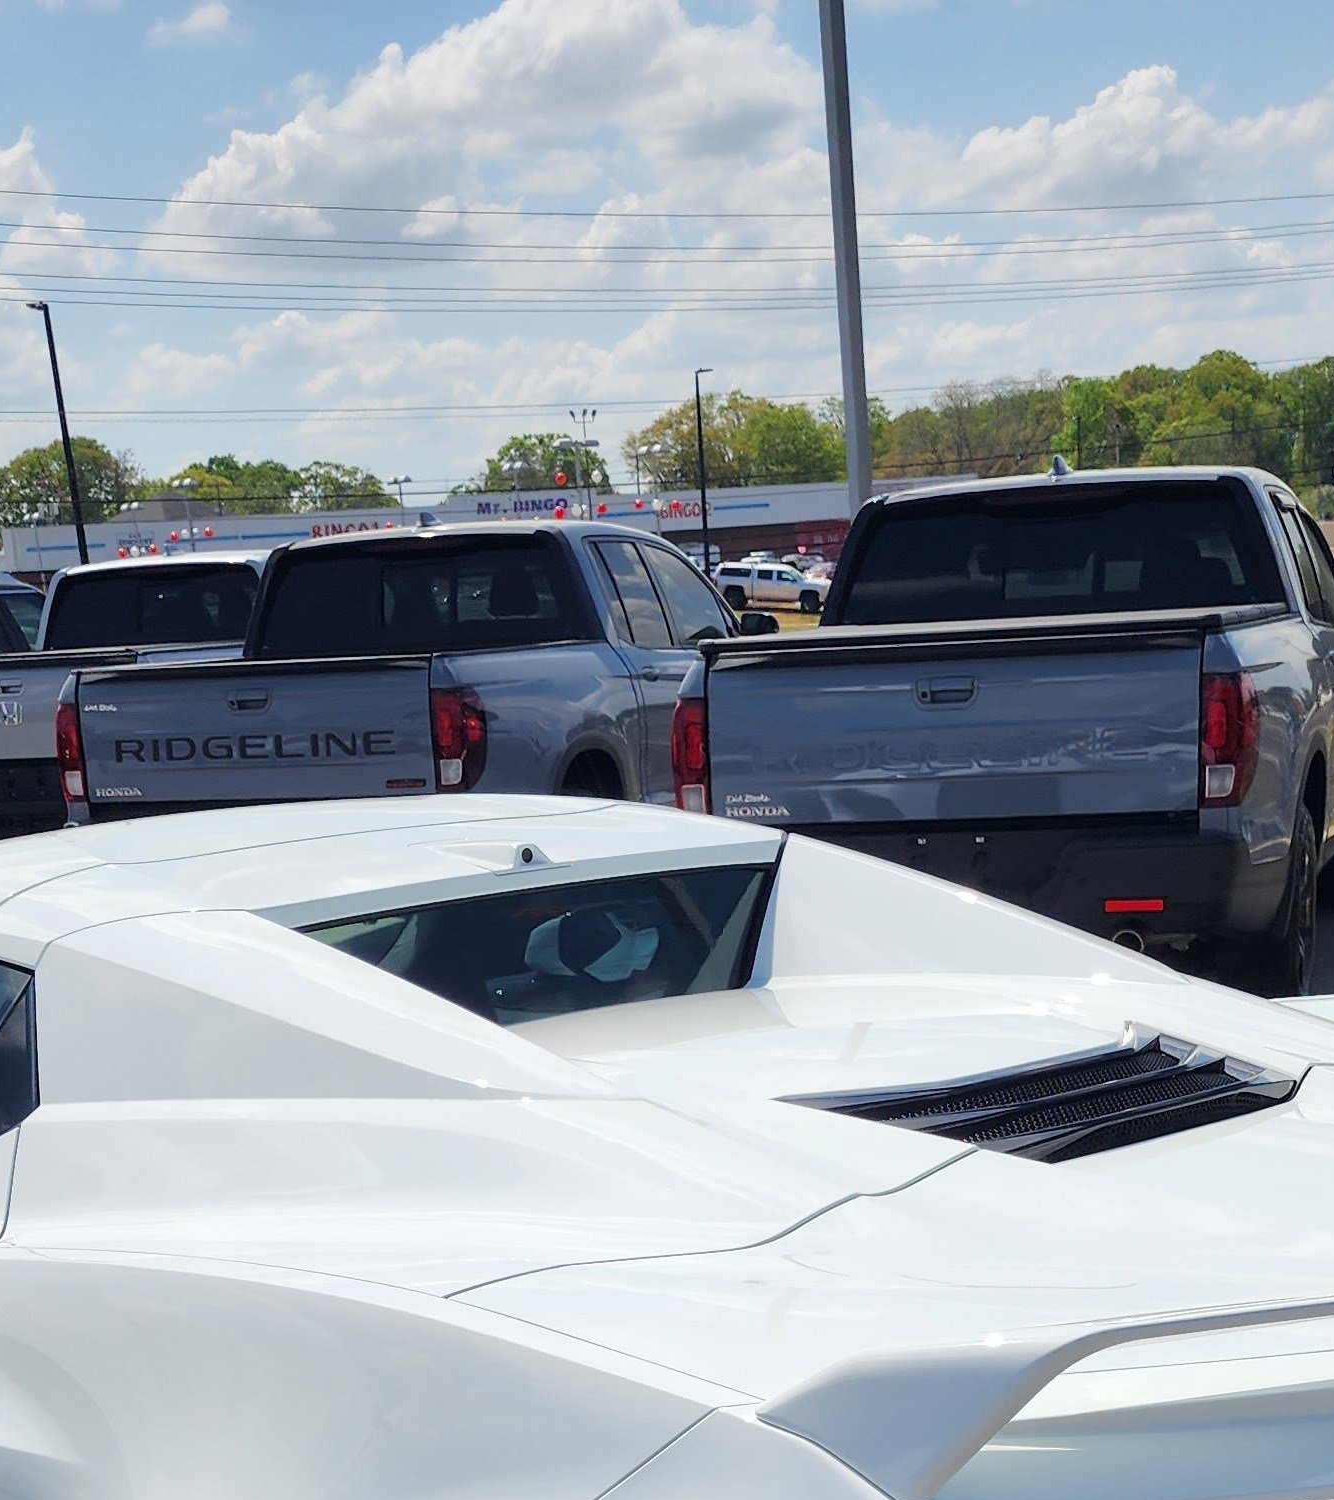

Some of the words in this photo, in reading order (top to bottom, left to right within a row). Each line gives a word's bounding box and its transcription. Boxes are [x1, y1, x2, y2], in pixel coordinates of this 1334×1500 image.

[114, 730, 397, 764] RIDGELINE
[95, 786, 143, 798] HONDA
[725, 805, 791, 818] HONDA
